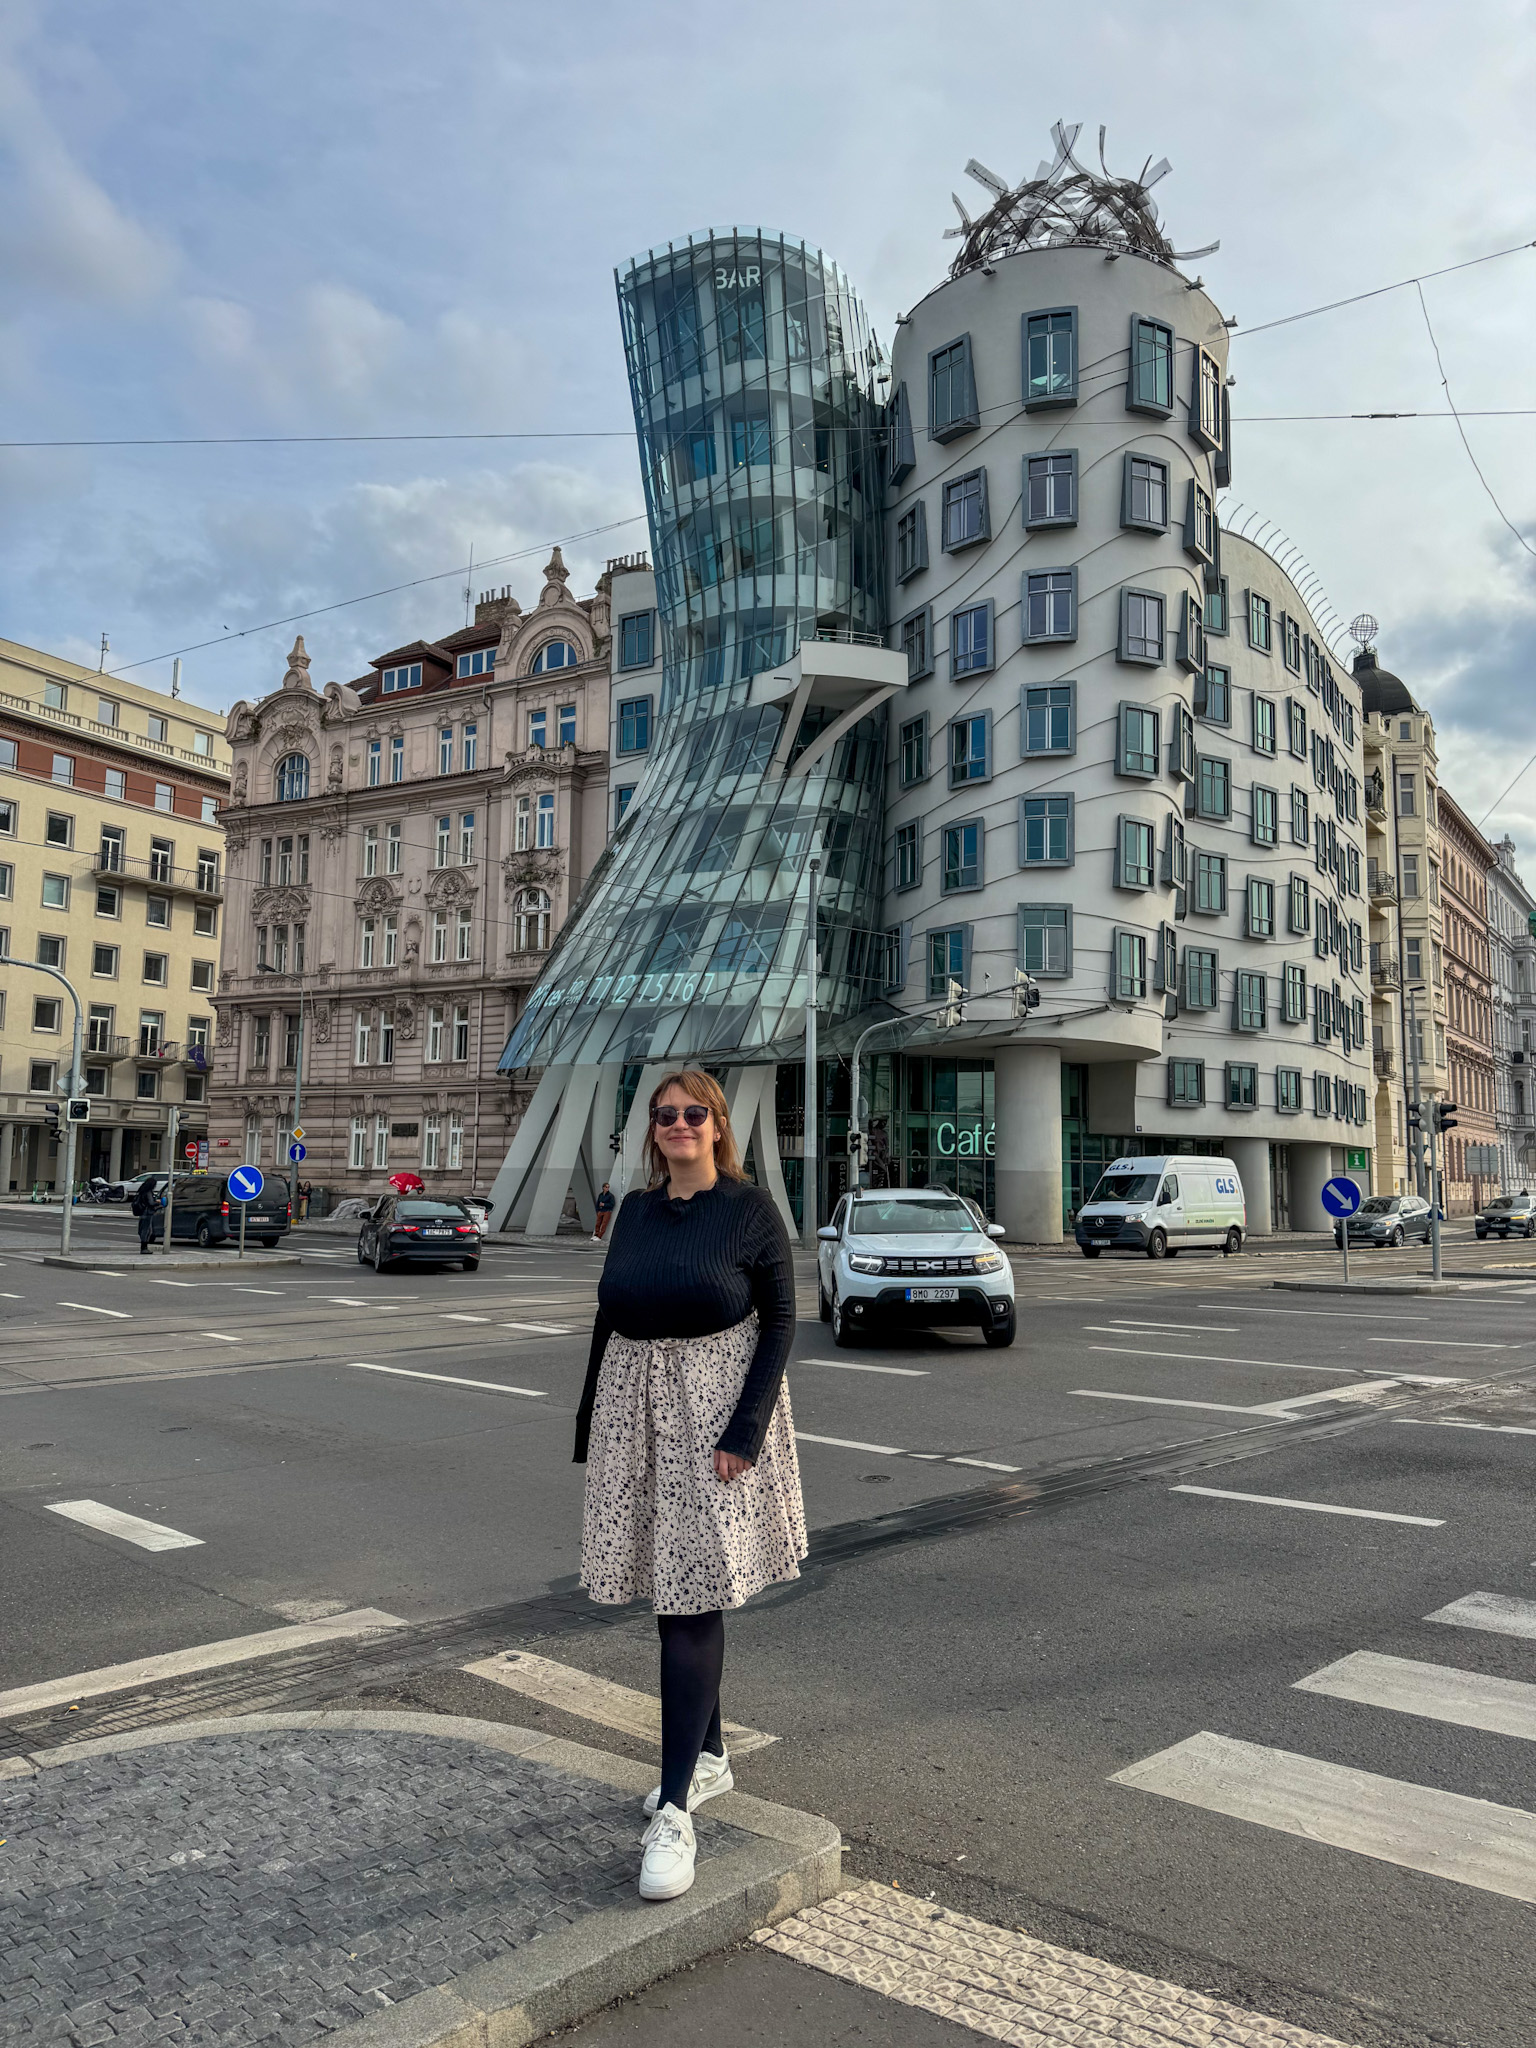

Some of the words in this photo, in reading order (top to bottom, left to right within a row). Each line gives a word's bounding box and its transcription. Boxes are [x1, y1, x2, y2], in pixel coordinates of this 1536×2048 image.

[715, 265, 761, 290] BAR
[937, 1122, 995, 1156] Café
[934, 1289, 955, 1299] 2297
